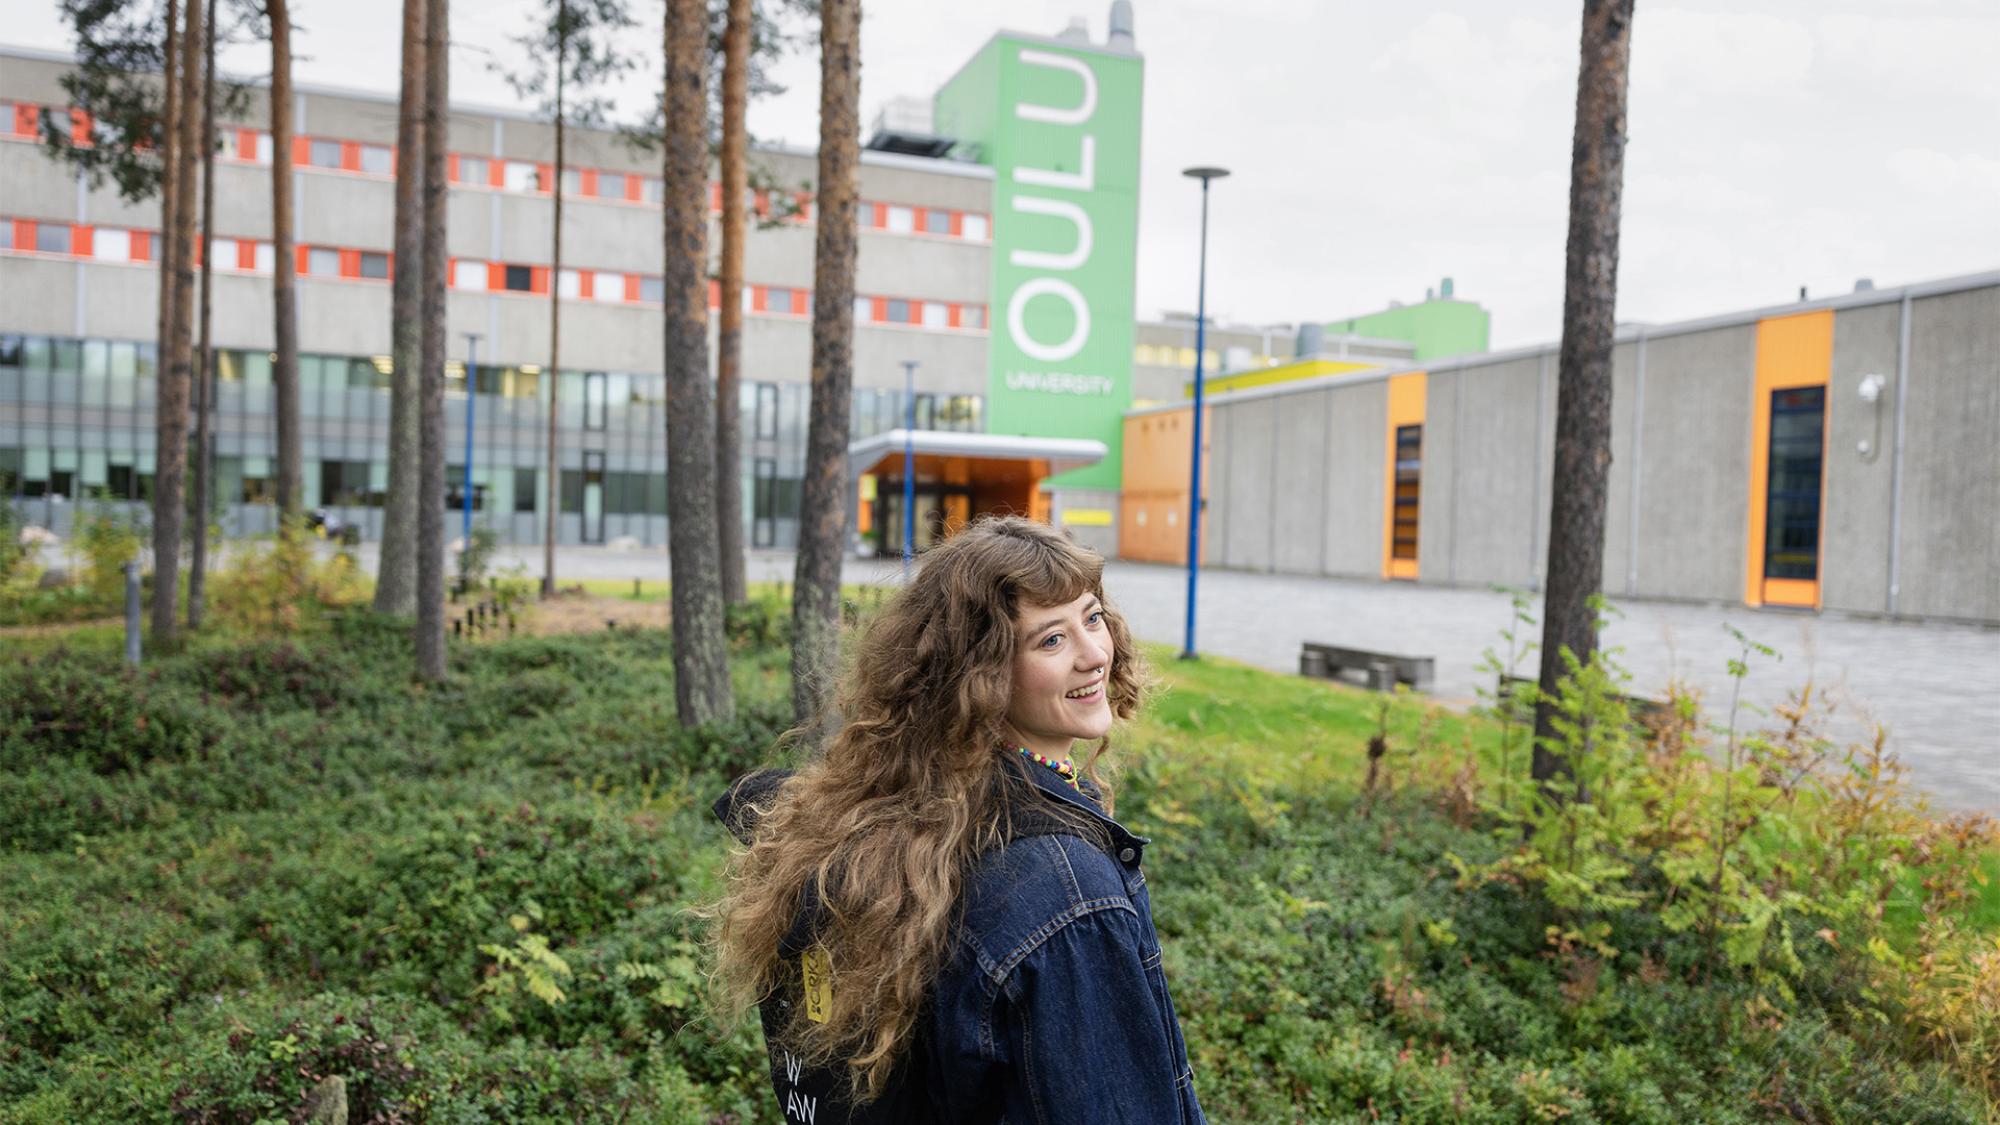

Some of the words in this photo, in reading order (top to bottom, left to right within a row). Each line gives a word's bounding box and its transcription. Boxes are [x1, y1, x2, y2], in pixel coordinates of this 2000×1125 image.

[1007, 48, 1098, 361] OULU
[1006, 371, 1113, 396] UNIVERSITY
[786, 1088, 817, 1125] AW
